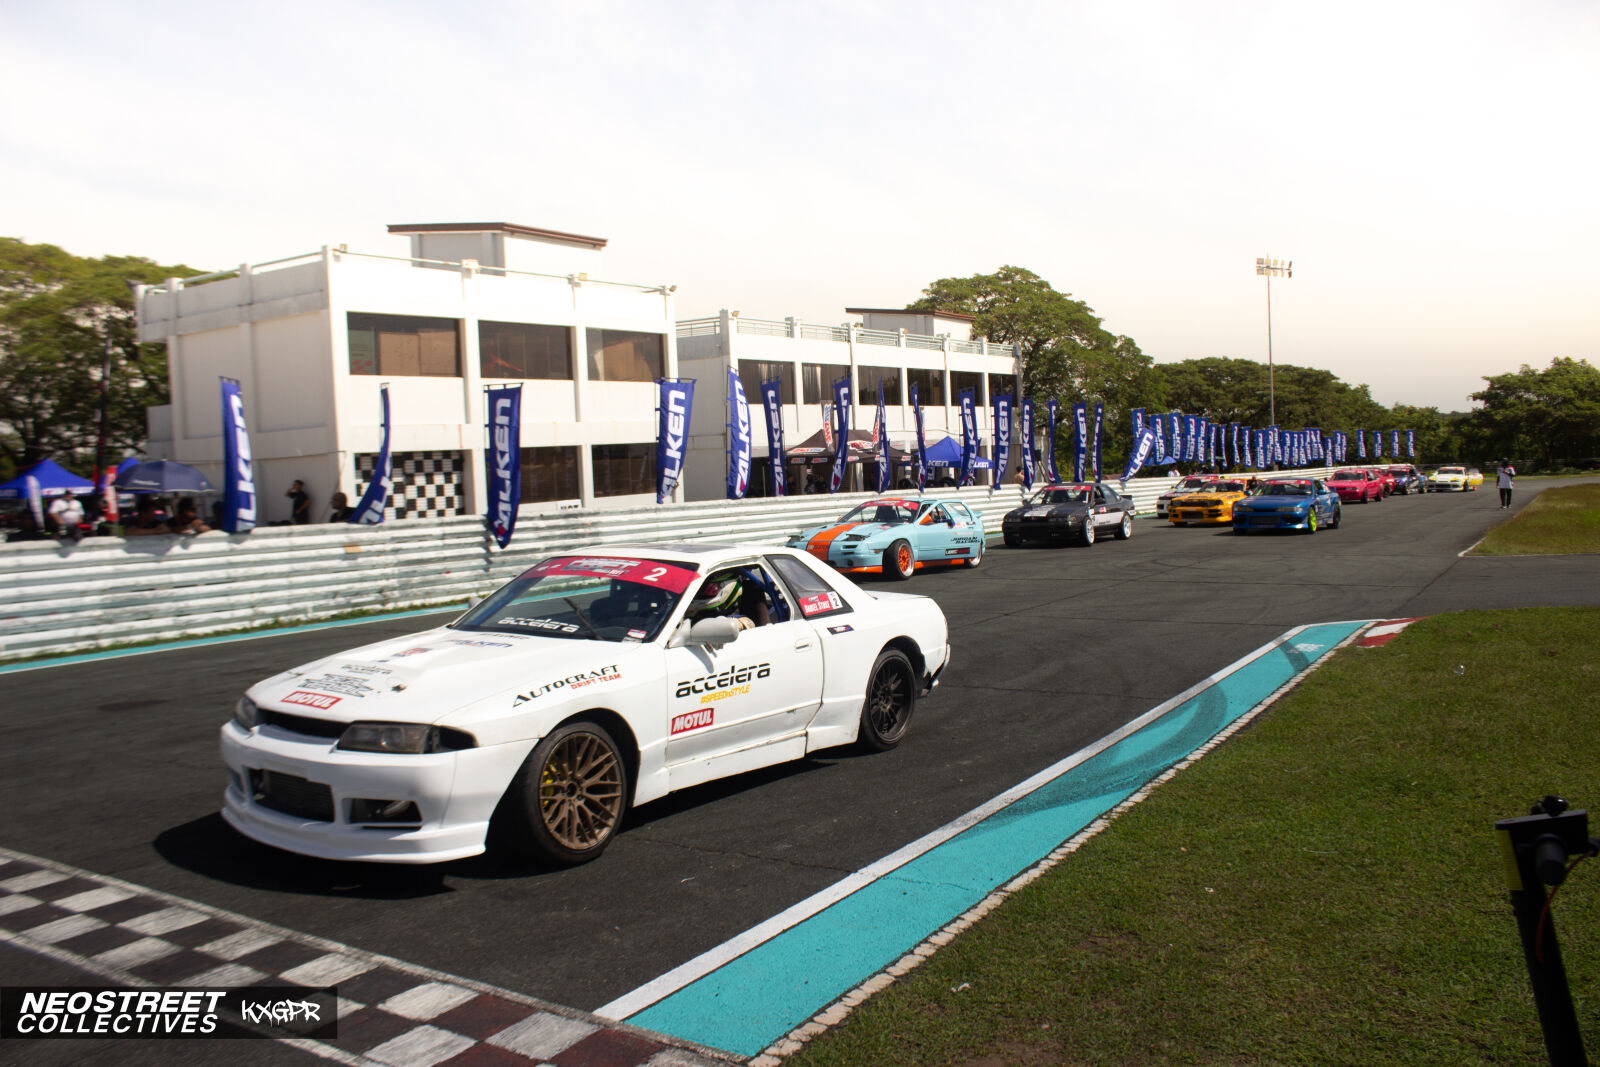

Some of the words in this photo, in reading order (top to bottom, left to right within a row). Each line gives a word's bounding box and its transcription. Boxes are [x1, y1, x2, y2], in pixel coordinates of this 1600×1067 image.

[661, 390, 686, 498] ALKEN
[643, 567, 668, 582] 2
[832, 597, 840, 607] 2
[497, 616, 581, 633] accelera
[512, 664, 619, 708] AUTOCRAFT
[570, 678, 598, 690] DRIFT
[598, 673, 623, 684] TEAM
[676, 662, 771, 698] accelera
[284, 691, 338, 709] MOTUL
[673, 709, 713, 732] MOTUL
